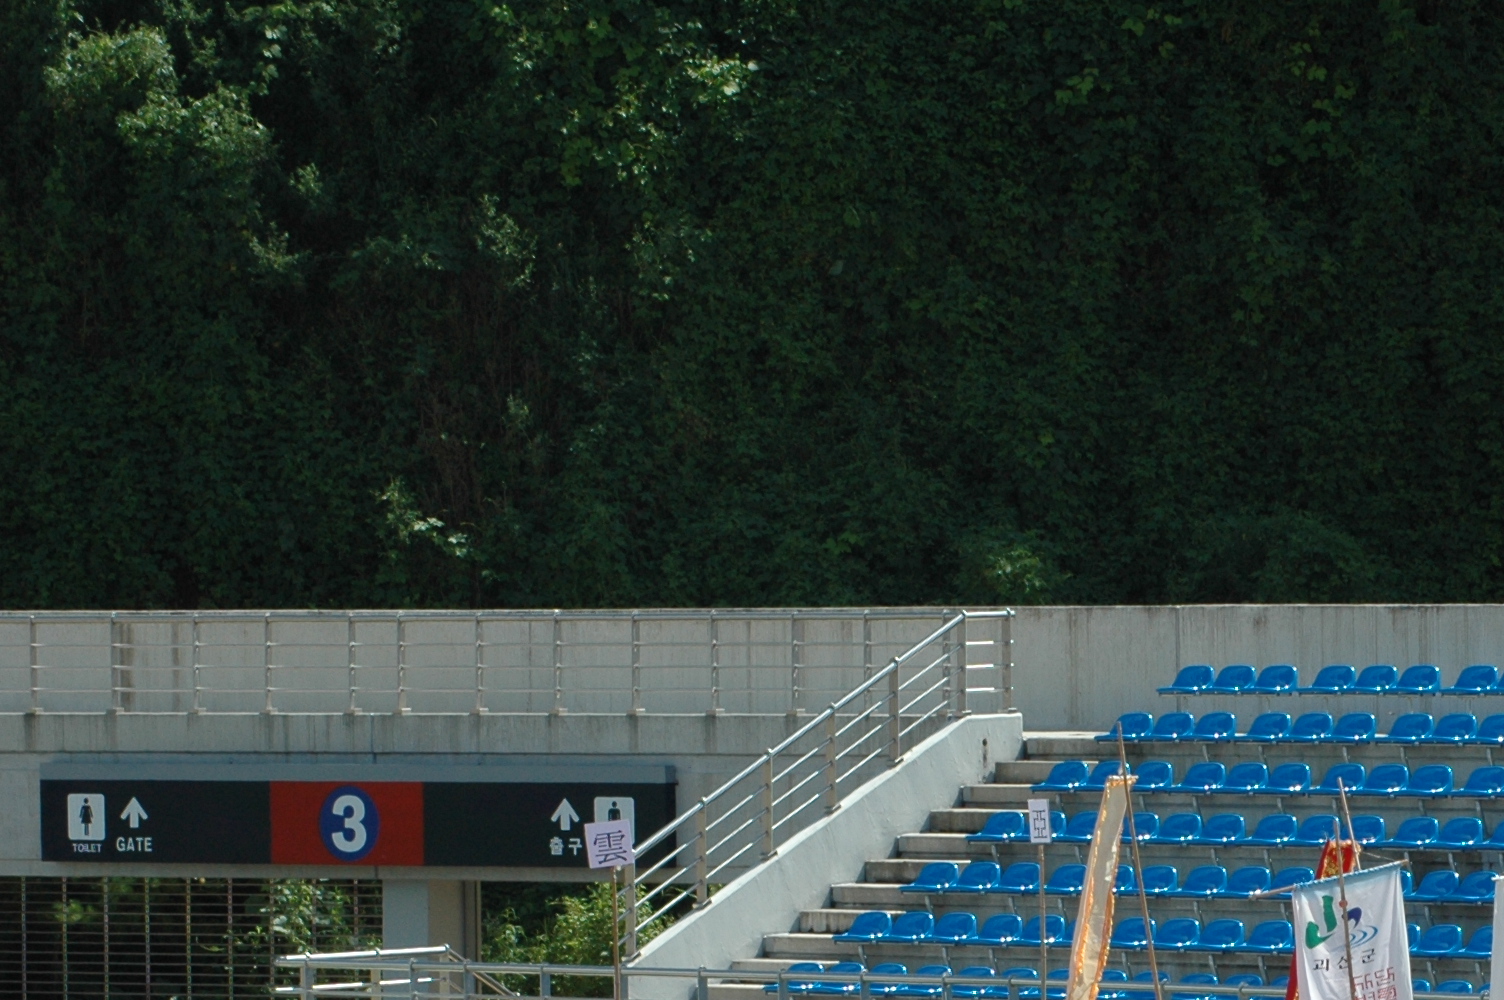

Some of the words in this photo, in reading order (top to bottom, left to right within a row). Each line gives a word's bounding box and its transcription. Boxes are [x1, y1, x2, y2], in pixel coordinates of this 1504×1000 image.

[331, 795, 368, 852] 3
[116, 836, 153, 852] GATE
[549, 836, 583, 856] 출구
[593, 830, 628, 865] 雲
[1311, 948, 1376, 972] 괴산군
